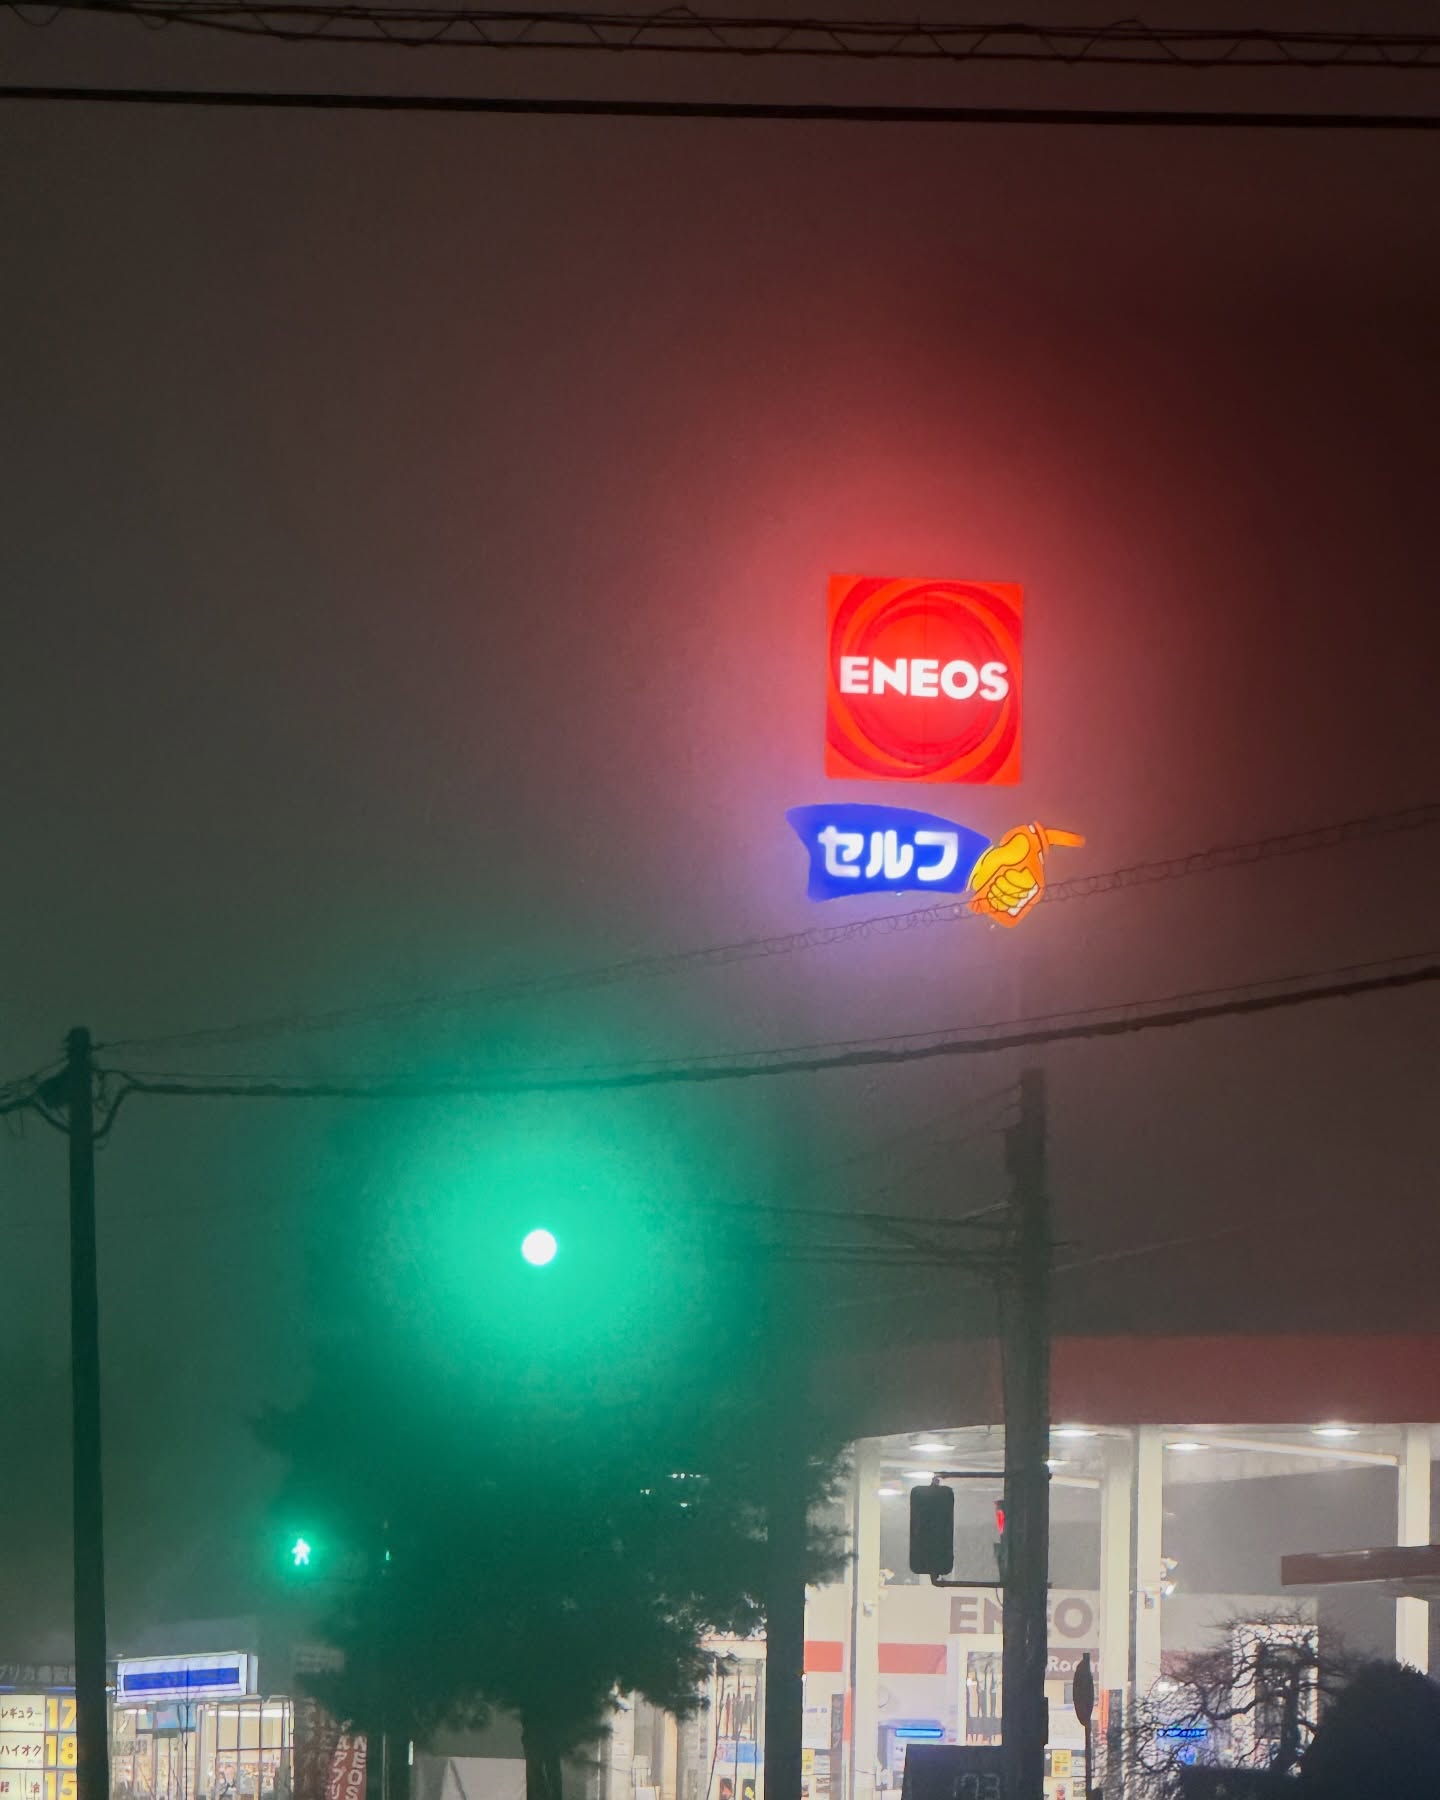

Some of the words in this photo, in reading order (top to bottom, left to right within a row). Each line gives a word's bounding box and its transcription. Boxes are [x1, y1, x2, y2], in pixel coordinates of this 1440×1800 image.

[840, 656, 1009, 701] ENEOS
[818, 825, 958, 881] セルフ
[1, 1706, 42, 1719] レギュラー
[0, 1744, 42, 1757] ハイオク
